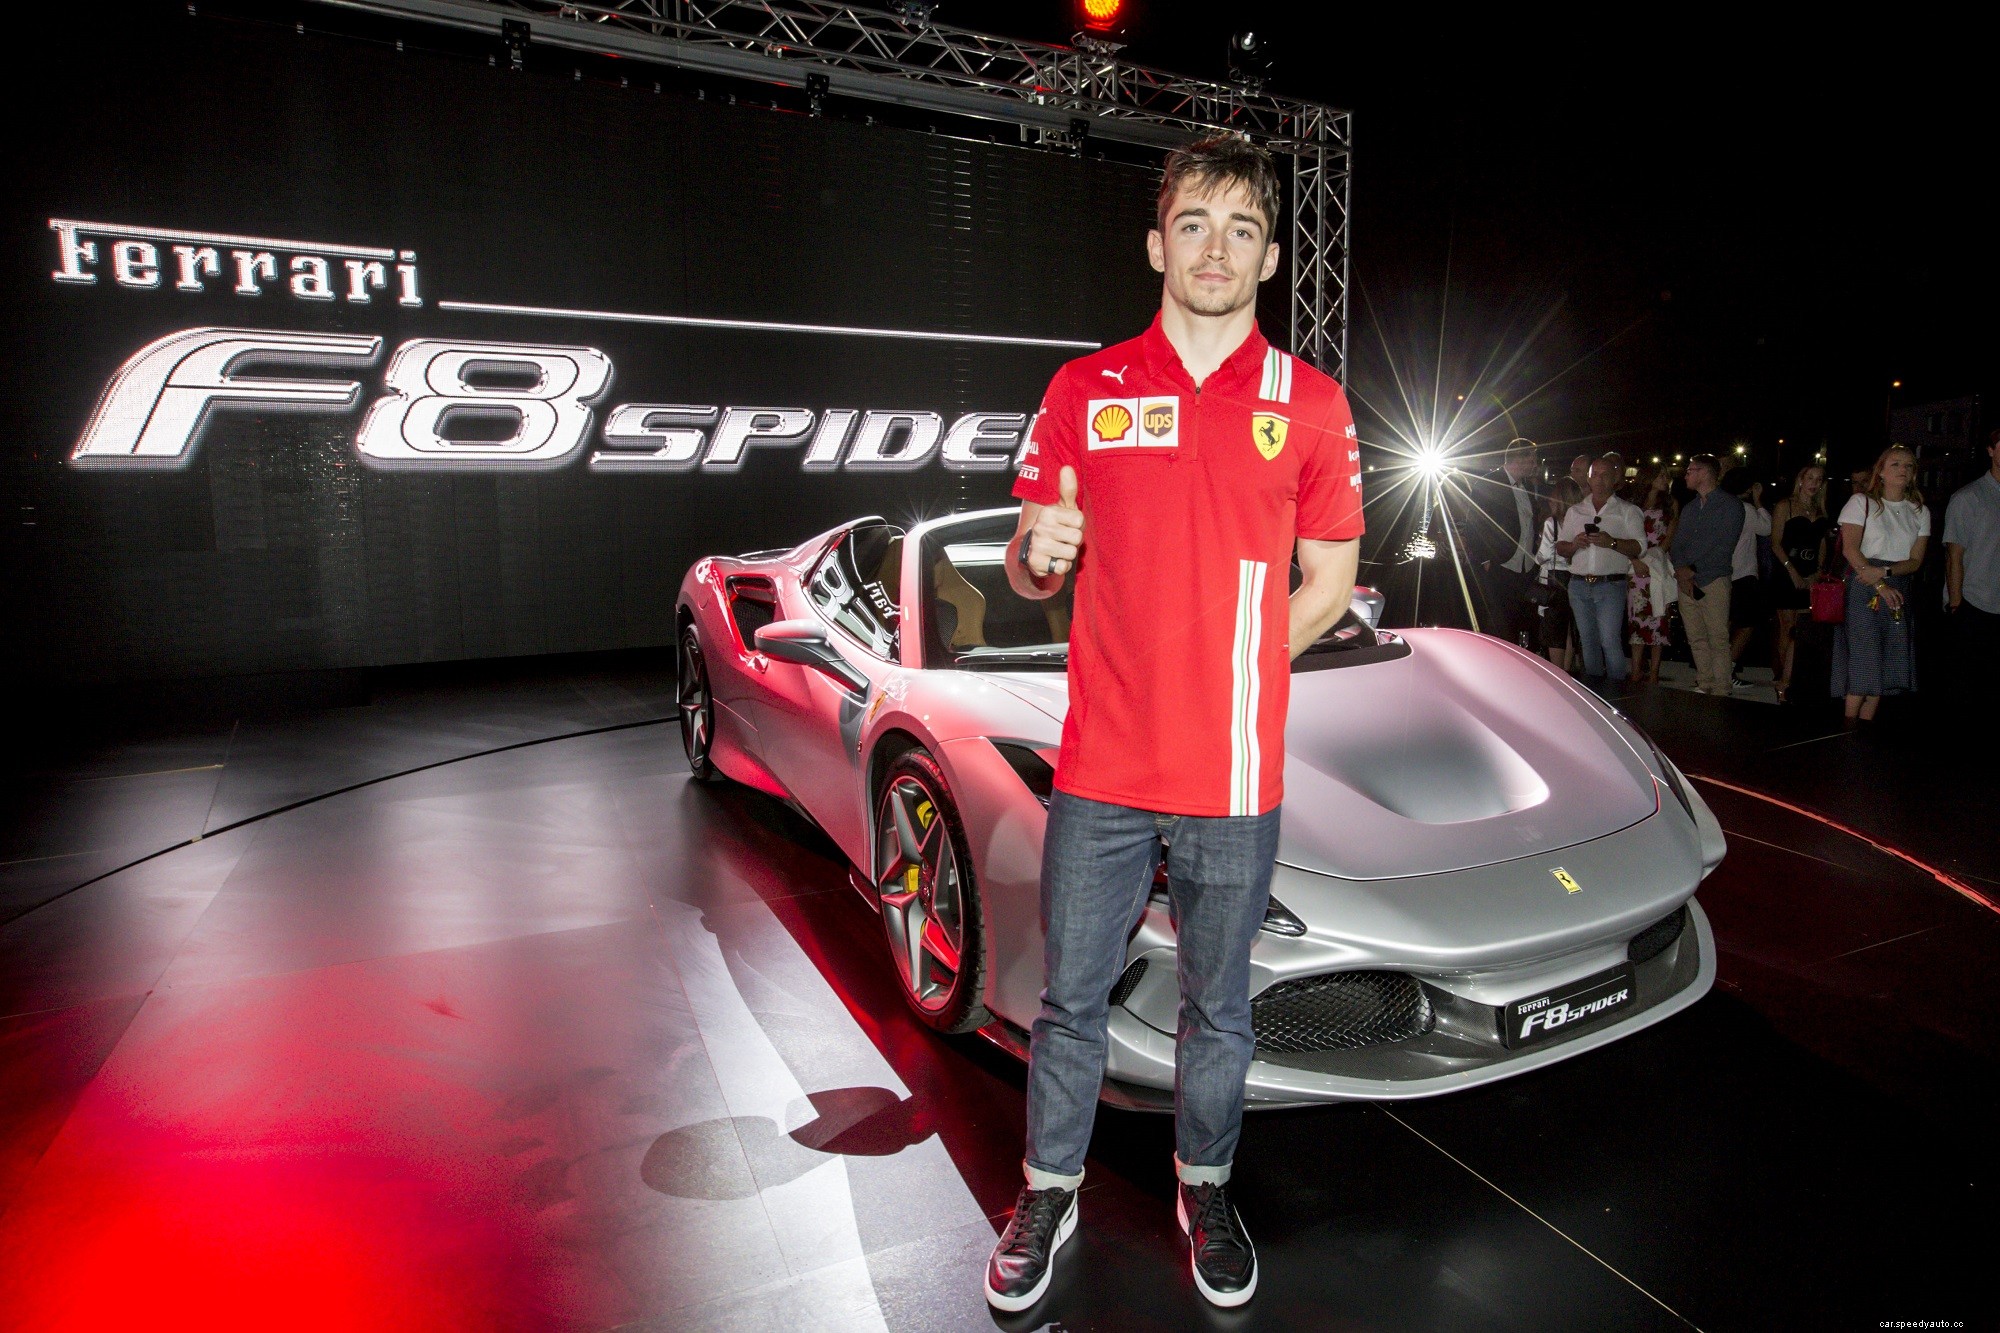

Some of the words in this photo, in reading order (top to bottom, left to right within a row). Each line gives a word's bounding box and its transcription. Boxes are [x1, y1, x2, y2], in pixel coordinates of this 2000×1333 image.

[48, 217, 424, 308] Ferrari
[70, 325, 613, 470] F8
[1145, 413, 1173, 434] ups
[1517, 996, 1551, 1015] Ferrari
[1519, 1002, 1570, 1039] F8
[1566, 988, 1628, 1022] SPIDER
